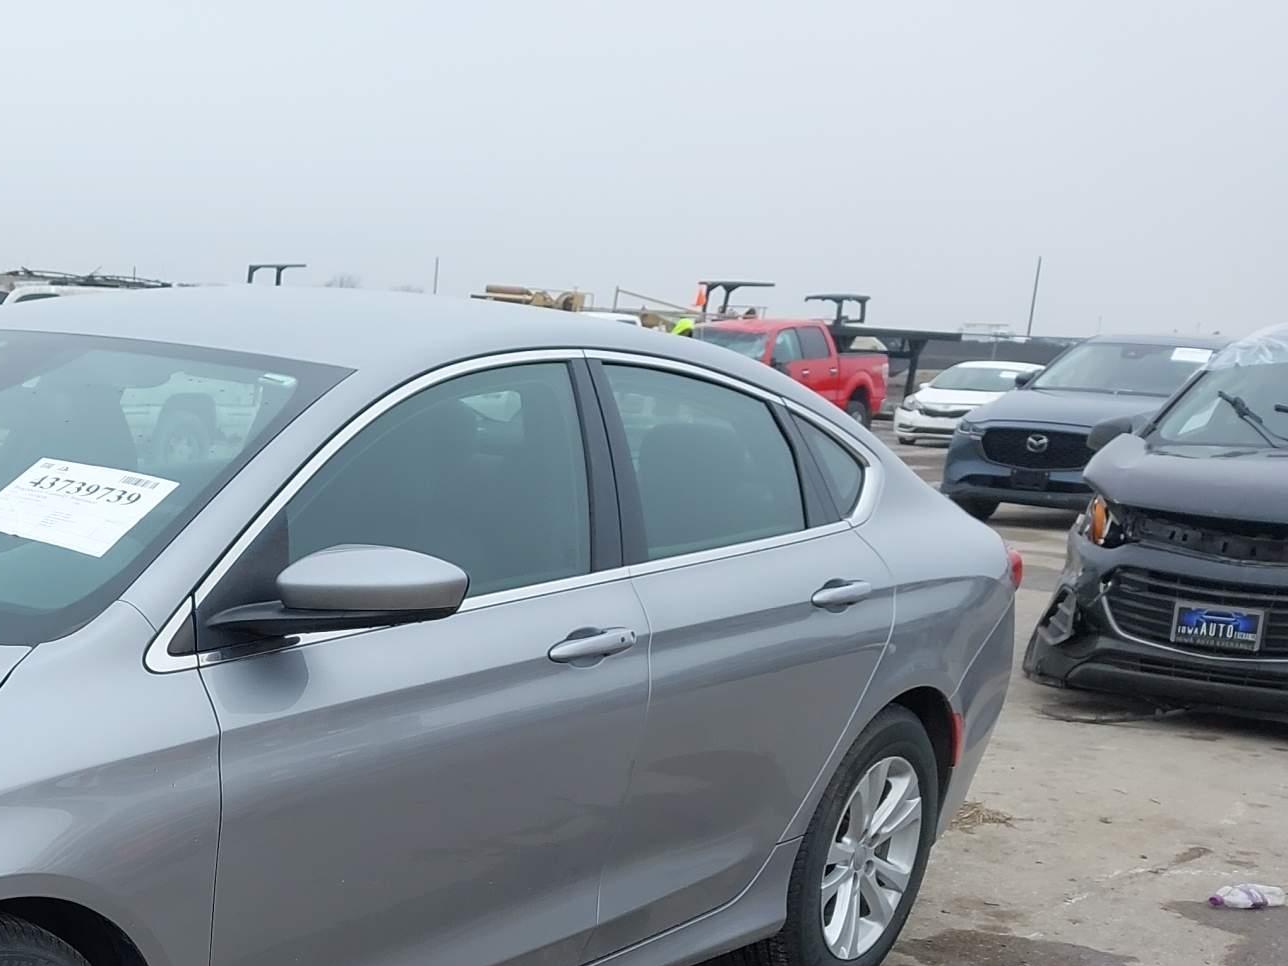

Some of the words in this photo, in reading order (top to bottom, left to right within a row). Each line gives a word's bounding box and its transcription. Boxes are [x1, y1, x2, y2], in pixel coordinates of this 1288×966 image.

[28, 475, 142, 506] 43739739
[1177, 625, 1198, 634] IOWA
[1199, 621, 1234, 639] AUTO
